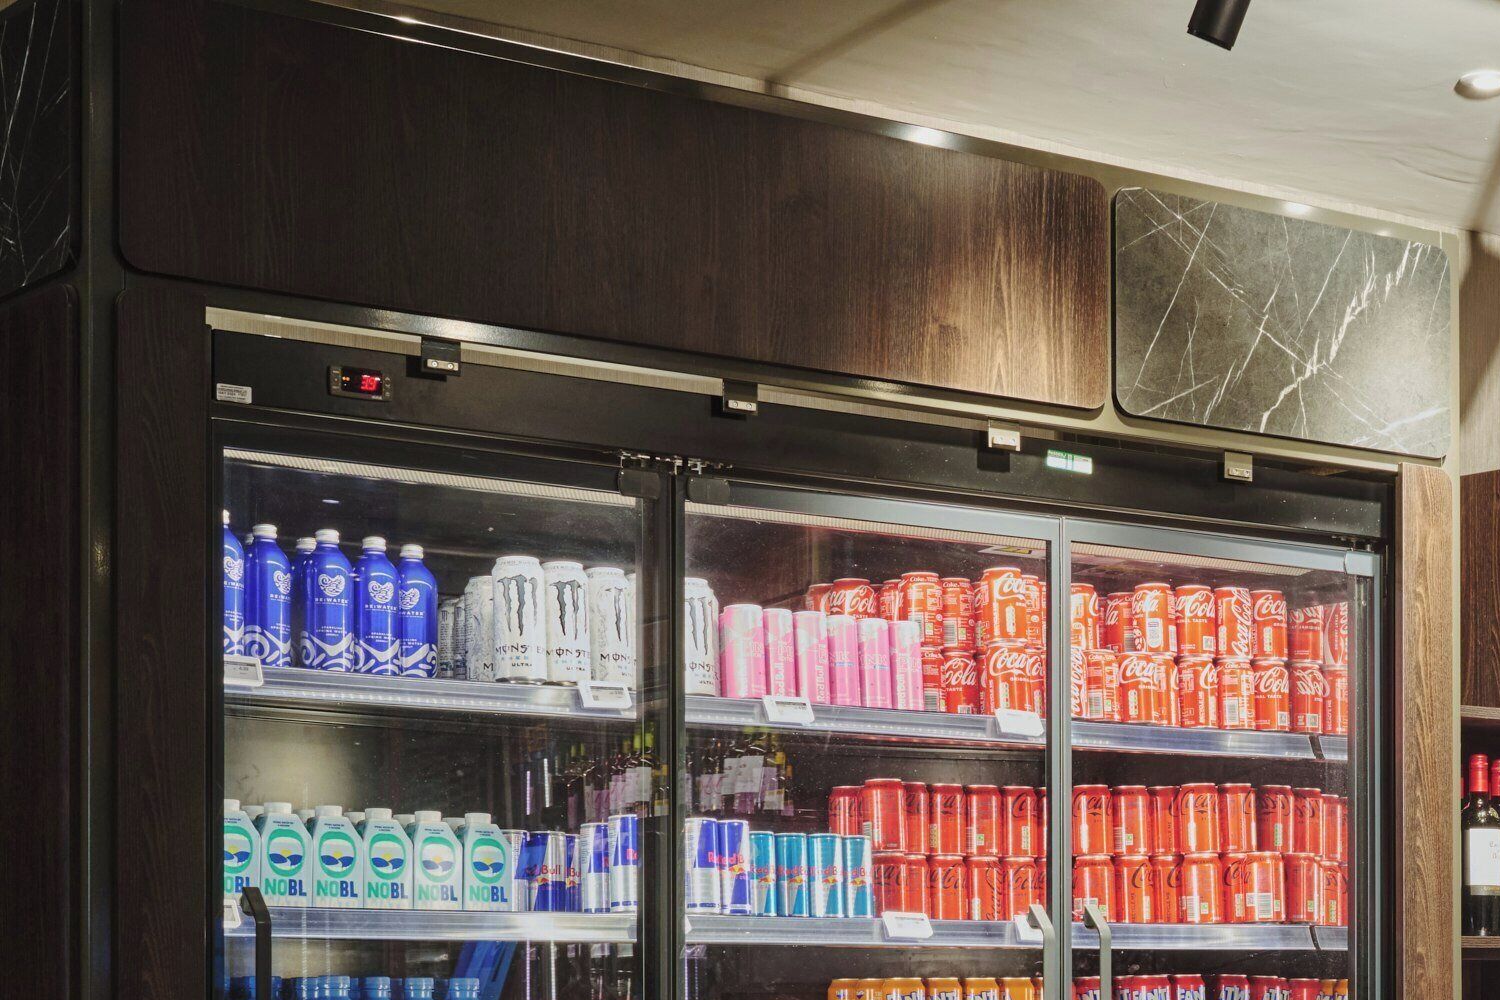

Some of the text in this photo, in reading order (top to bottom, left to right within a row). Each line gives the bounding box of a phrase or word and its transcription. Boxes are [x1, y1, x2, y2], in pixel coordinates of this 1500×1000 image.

[541, 864, 561, 876] Bull
[264, 878, 307, 897] NOBL
[316, 879, 358, 898] NOBL
[367, 880, 408, 900] NOBL
[417, 883, 458, 902] NOBL
[469, 885, 508, 903] NOBL
